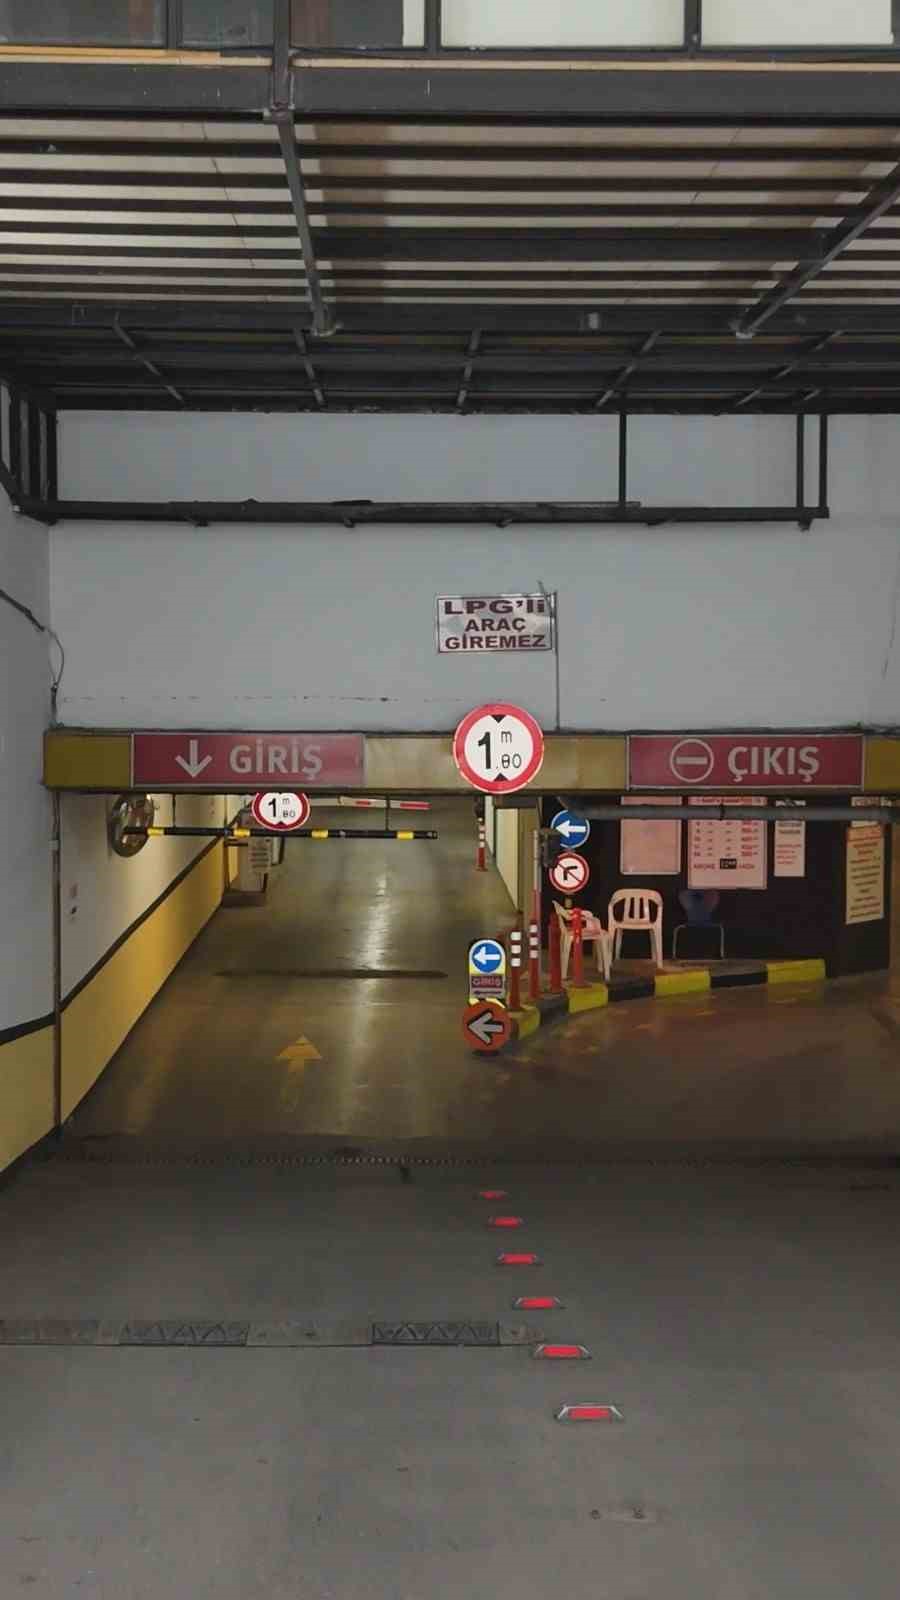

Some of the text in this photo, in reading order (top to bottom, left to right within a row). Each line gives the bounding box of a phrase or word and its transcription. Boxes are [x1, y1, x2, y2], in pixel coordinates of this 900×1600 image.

[444, 600, 545, 614] LPG'li
[465, 618, 526, 632] ARAÇ
[445, 634, 546, 649] GİREMEZ
[229, 740, 322, 781] GİRİŞ
[727, 746, 820, 782] ÇIKIŞ
